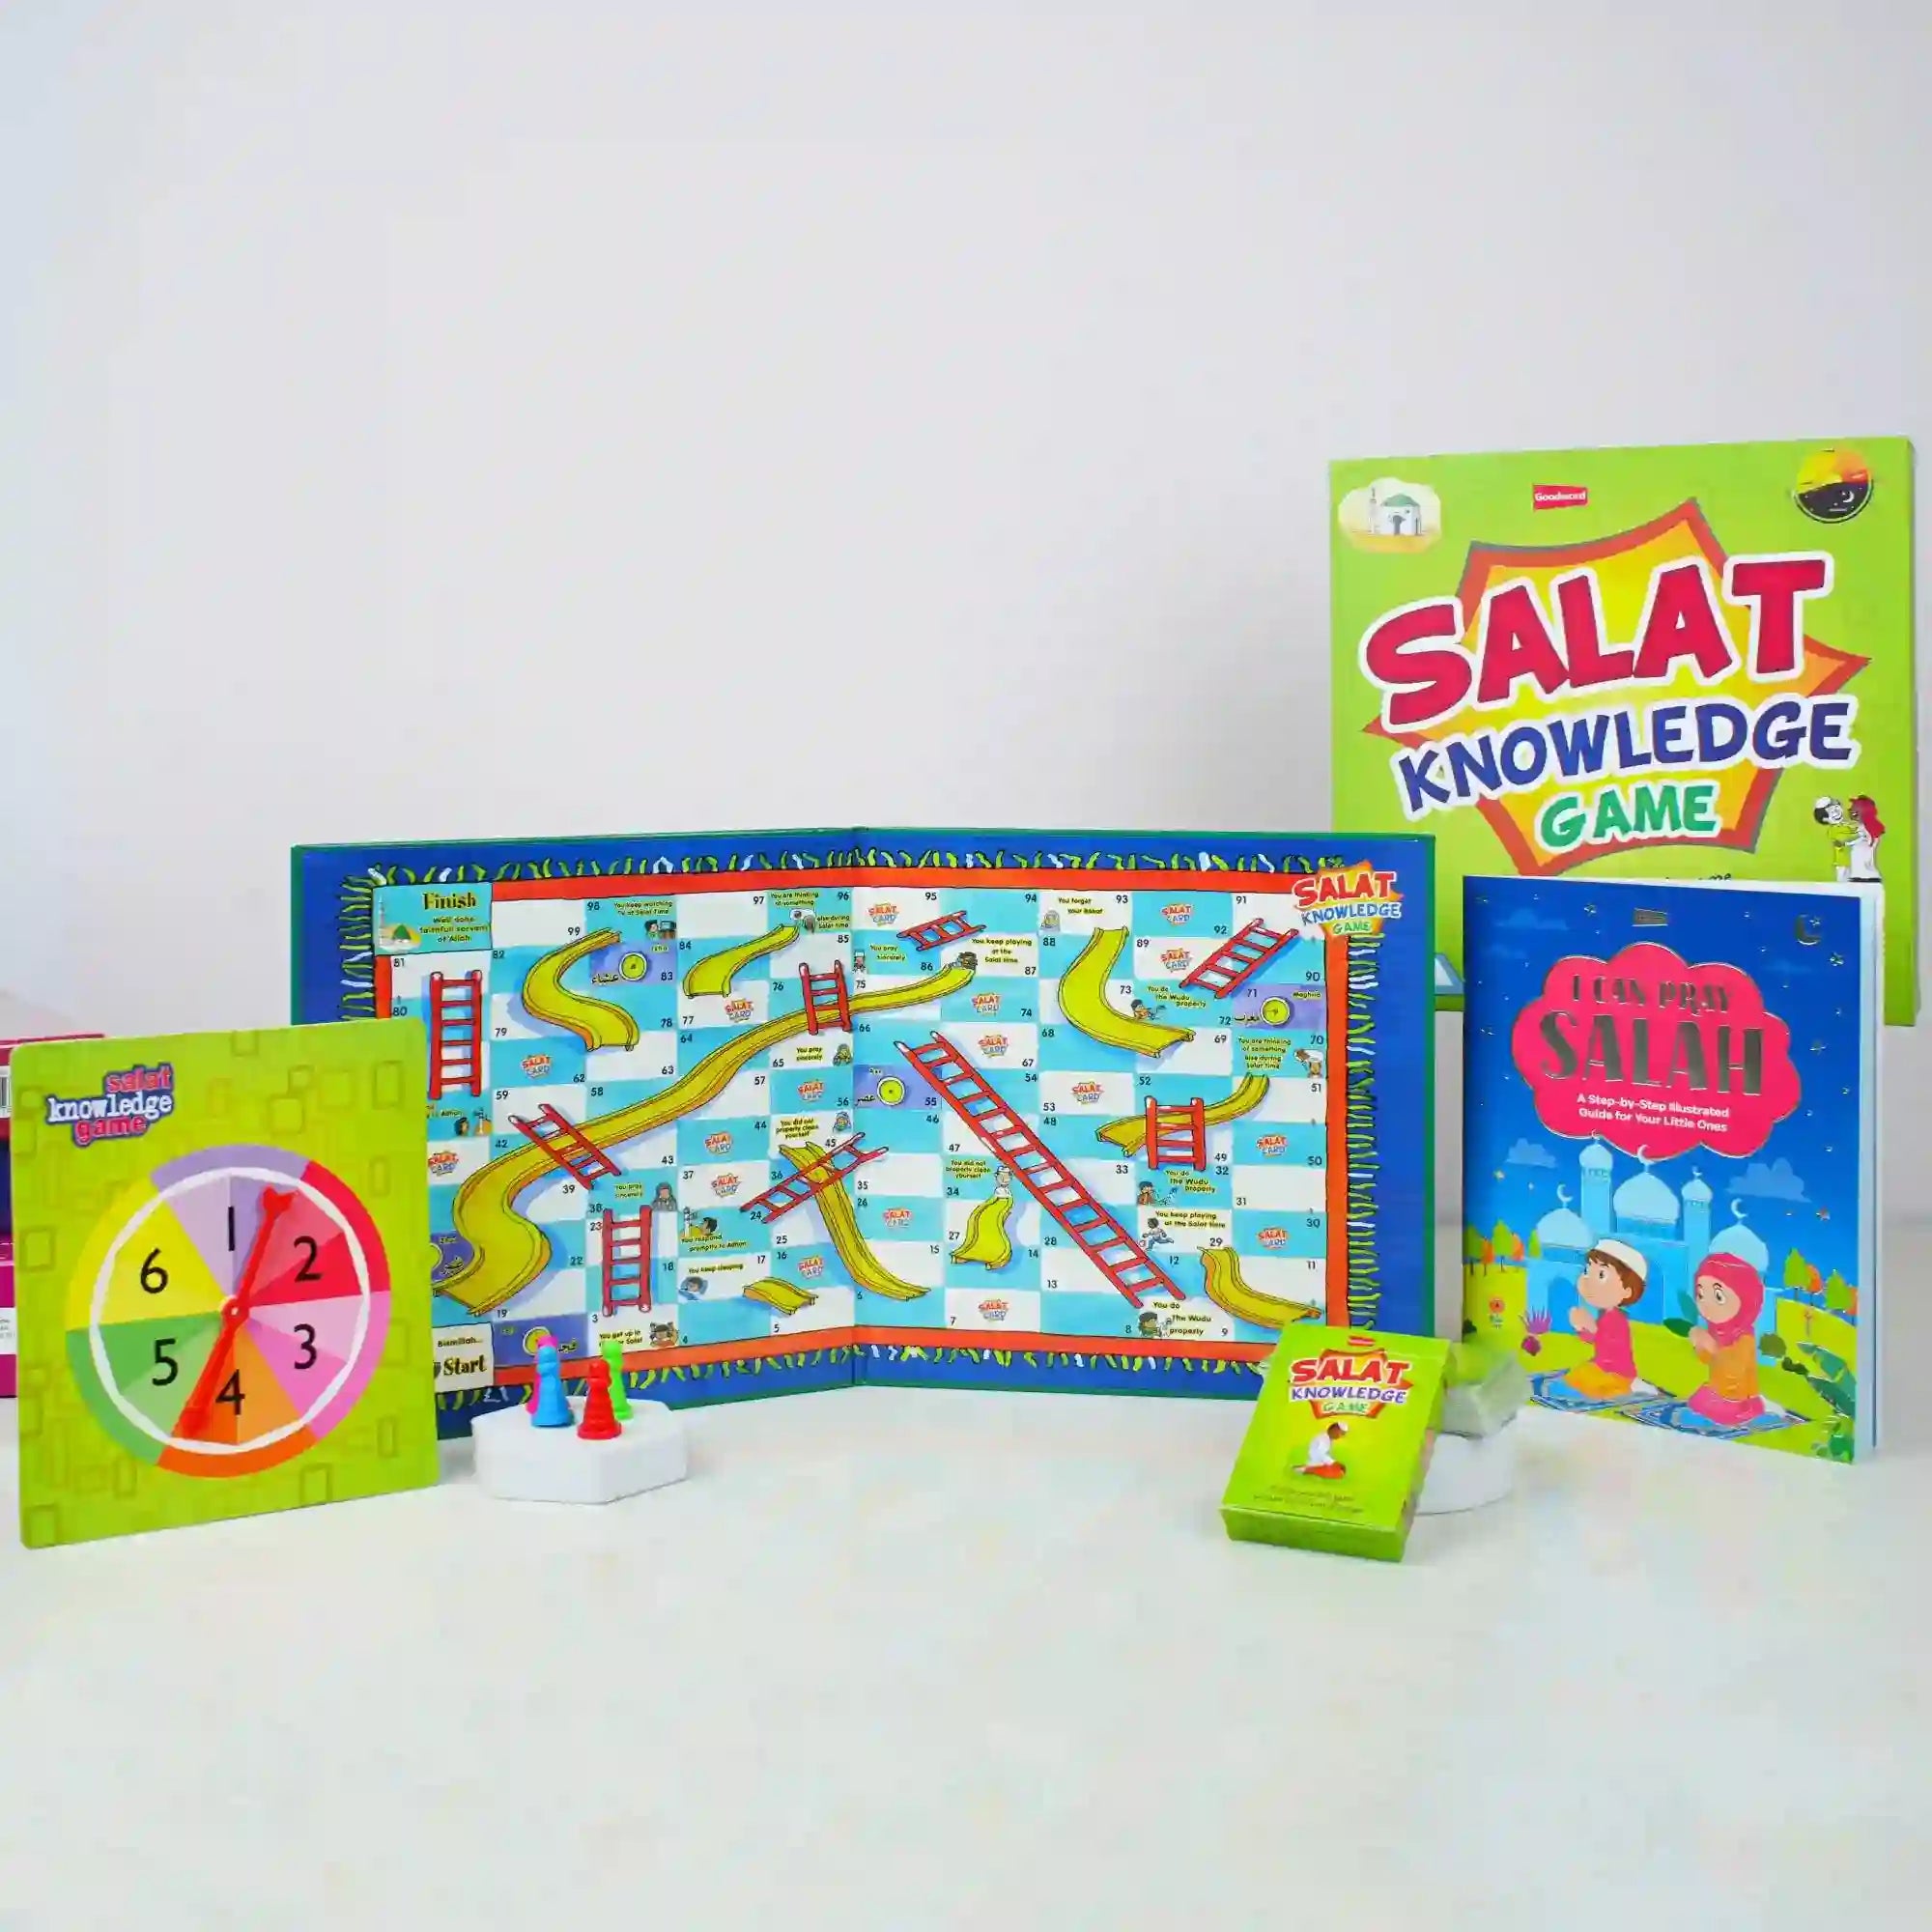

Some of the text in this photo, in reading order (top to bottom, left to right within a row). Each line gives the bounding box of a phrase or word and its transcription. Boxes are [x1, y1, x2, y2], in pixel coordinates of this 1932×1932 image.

[1366, 560, 1825, 724] SALAT
[1401, 703, 1851, 811] KNOWLEDGE
[1541, 785, 1716, 846] GAME
[1294, 873, 1395, 907] SALAT
[753, 896, 765, 905] 97
[838, 892, 849, 900] 96
[1025, 894, 1037, 902] 94
[1116, 895, 1128, 904] 93
[422, 893, 476, 910] Finish
[587, 902, 600, 911] 98
[1161, 906, 1190, 916] SALAT
[1302, 902, 1401, 925] KNOWLEDGE
[568, 927, 581, 936] 99
[1333, 922, 1371, 934] GAME
[838, 934, 849, 943] 85
[1007, 938, 1033, 947] playing
[1043, 938, 1055, 947] 88
[680, 941, 692, 950] 84
[494, 951, 504, 959] 82
[1161, 951, 1190, 961] SALAT
[394, 958, 405, 967] 81
[1025, 966, 1036, 975] 87
[661, 972, 673, 980] 83
[1306, 972, 1320, 981] 90
[773, 982, 783, 991] 76
[856, 980, 866, 988] 75
[1121, 985, 1132, 994] 73
[1247, 989, 1257, 998] 71
[1573, 976, 1731, 1016] I CAN PRAY
[972, 996, 1001, 1006] SALAT
[393, 1007, 407, 1016] 80
[1021, 1009, 1033, 1017] 74
[661, 1019, 672, 1028] 78
[683, 1016, 694, 1025] 77
[1219, 1016, 1231, 1025] 72
[495, 1028, 507, 1037] 79
[1042, 1029, 1054, 1037] 68
[680, 1034, 693, 1042] 64
[979, 1036, 1008, 1046] SALAT
[1311, 1036, 1323, 1045] 70
[1540, 1010, 1762, 1095] SALAH
[773, 1059, 784, 1067] 65
[1022, 1059, 1034, 1067] 67
[662, 1066, 673, 1075] 63
[107, 1065, 172, 1094] salat
[574, 1074, 585, 1083] 62
[1025, 1073, 1037, 1082] 54
[1139, 1077, 1151, 1086] 52
[591, 1088, 603, 1096] 58
[1072, 1082, 1103, 1094] SALAT
[1311, 1083, 1321, 1093] 51
[496, 1091, 508, 1100] 59
[1077, 1093, 1100, 1102] CARD
[925, 1097, 936, 1106] 55
[1577, 1094, 1729, 1118] A Step-by-Step Illustrated
[48, 1094, 172, 1122] knowledge
[1043, 1103, 1056, 1112] 53
[1579, 1109, 1727, 1132] Guide for Your Little Ones
[75, 1117, 145, 1144] game
[825, 1139, 836, 1148] 45
[662, 1155, 674, 1164] 43
[1308, 1156, 1321, 1166] 50
[1116, 1165, 1128, 1175] 33
[1215, 1166, 1229, 1175] 32
[683, 1171, 695, 1179] 37
[771, 1171, 783, 1179] 36
[712, 1176, 739, 1187] SALAT
[858, 1181, 867, 1190] 35
[562, 1184, 575, 1194] 39
[947, 1187, 959, 1196] 34
[857, 1198, 867, 1207] 26
[751, 1212, 762, 1221] 24
[590, 1222, 602, 1231] 23
[1306, 1218, 1321, 1228] 30
[228, 1207, 235, 1251] 1
[776, 1236, 787, 1244] 25
[949, 1232, 960, 1240] 27
[1209, 1238, 1223, 1247] 29
[930, 1245, 940, 1254] 15
[294, 1236, 323, 1282] 2
[757, 1256, 766, 1264] 17
[778, 1251, 786, 1260] 16
[1169, 1256, 1179, 1264] 12
[664, 1263, 673, 1271] 18
[1307, 1261, 1316, 1269] 11
[140, 1249, 168, 1293] 6
[592, 1314, 598, 1323] 3
[950, 1317, 956, 1325] 7
[775, 1324, 780, 1333] 5
[1125, 1324, 1131, 1334] 8
[1221, 1327, 1228, 1336] 9
[294, 1324, 317, 1369] 3
[152, 1338, 178, 1385] 5
[443, 1354, 487, 1376] Start
[1292, 1359, 1410, 1384] SALAT
[215, 1369, 244, 1415] 4
[1292, 1387, 1406, 1403] KNOWLEDGE
[1323, 1403, 1368, 1413] GAME
